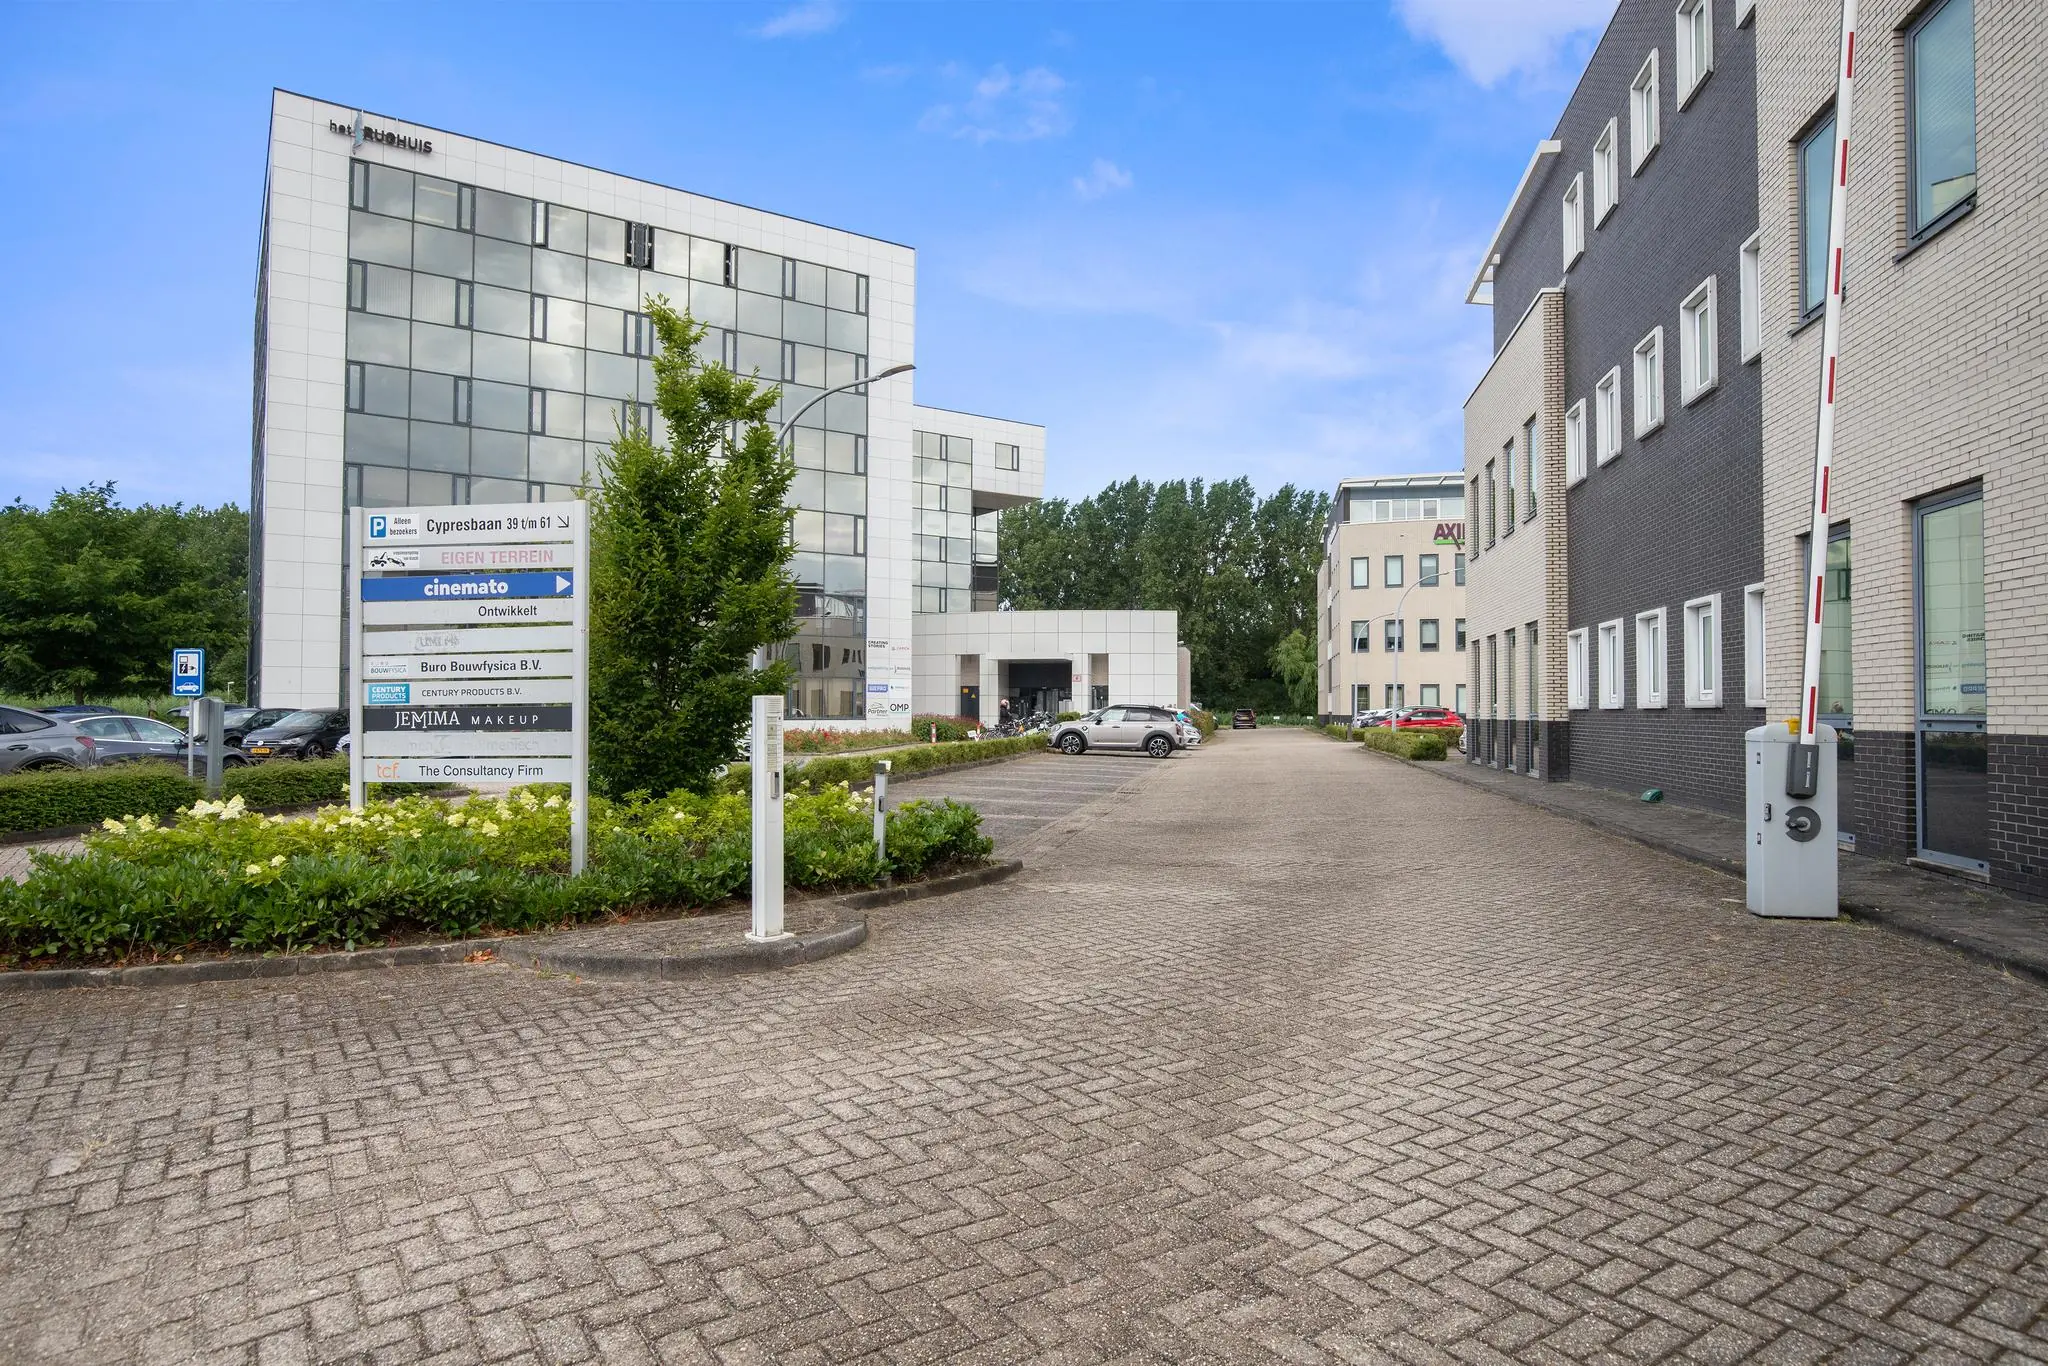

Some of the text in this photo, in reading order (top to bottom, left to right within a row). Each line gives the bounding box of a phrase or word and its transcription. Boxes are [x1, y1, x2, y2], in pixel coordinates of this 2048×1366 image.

[329, 120, 352, 135] het
[393, 517, 412, 525] Alleen
[426, 516, 551, 534] Cypresbaan 39 t/m 61
[389, 528, 418, 536] bezoekers
[441, 549, 554, 564] EIGEN TERREIN
[423, 578, 509, 596] cinemato
[478, 605, 538, 617] Ontwikkelt
[420, 659, 542, 674] Buro Bouwfysica B.V.
[421, 689, 459, 697] CENTURY
[461, 688, 505, 697] PRODUCTS
[889, 703, 909, 712] OMP
[394, 710, 539, 729] JEMIMA MAKEUP
[418, 765, 440, 777] The
[443, 764, 514, 779] Consultancy
[517, 764, 544, 776] Firm
